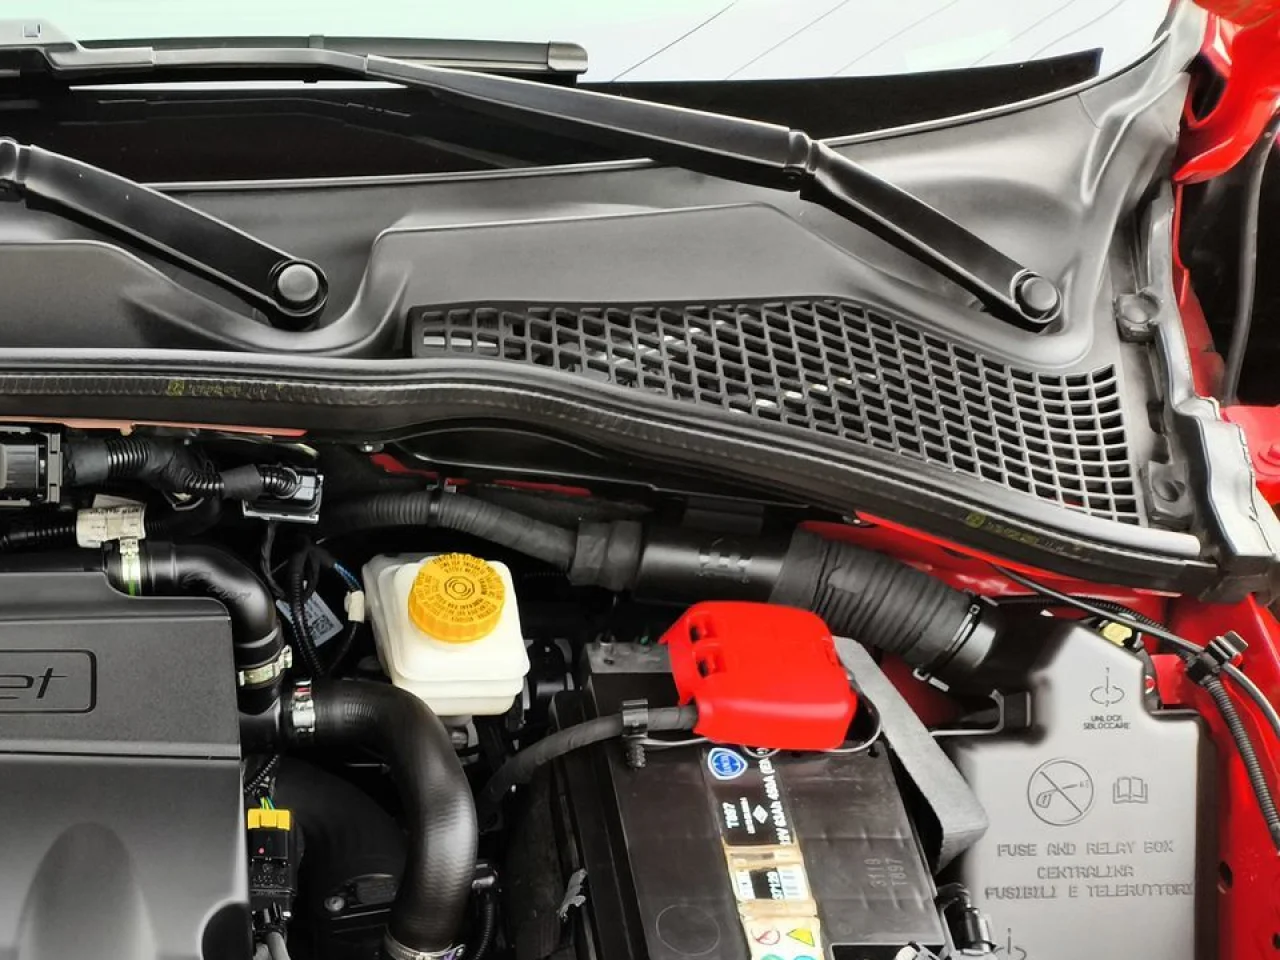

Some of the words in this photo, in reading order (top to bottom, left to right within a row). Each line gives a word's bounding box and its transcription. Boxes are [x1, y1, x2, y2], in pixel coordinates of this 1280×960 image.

[997, 843, 1037, 857] FUSE
[1046, 842, 1077, 856] AND
[1086, 841, 1136, 855] RELAY
[1143, 839, 1174, 853] BOX
[1037, 864, 1134, 879] CENTRALINA
[1068, 884, 1079, 898] E
